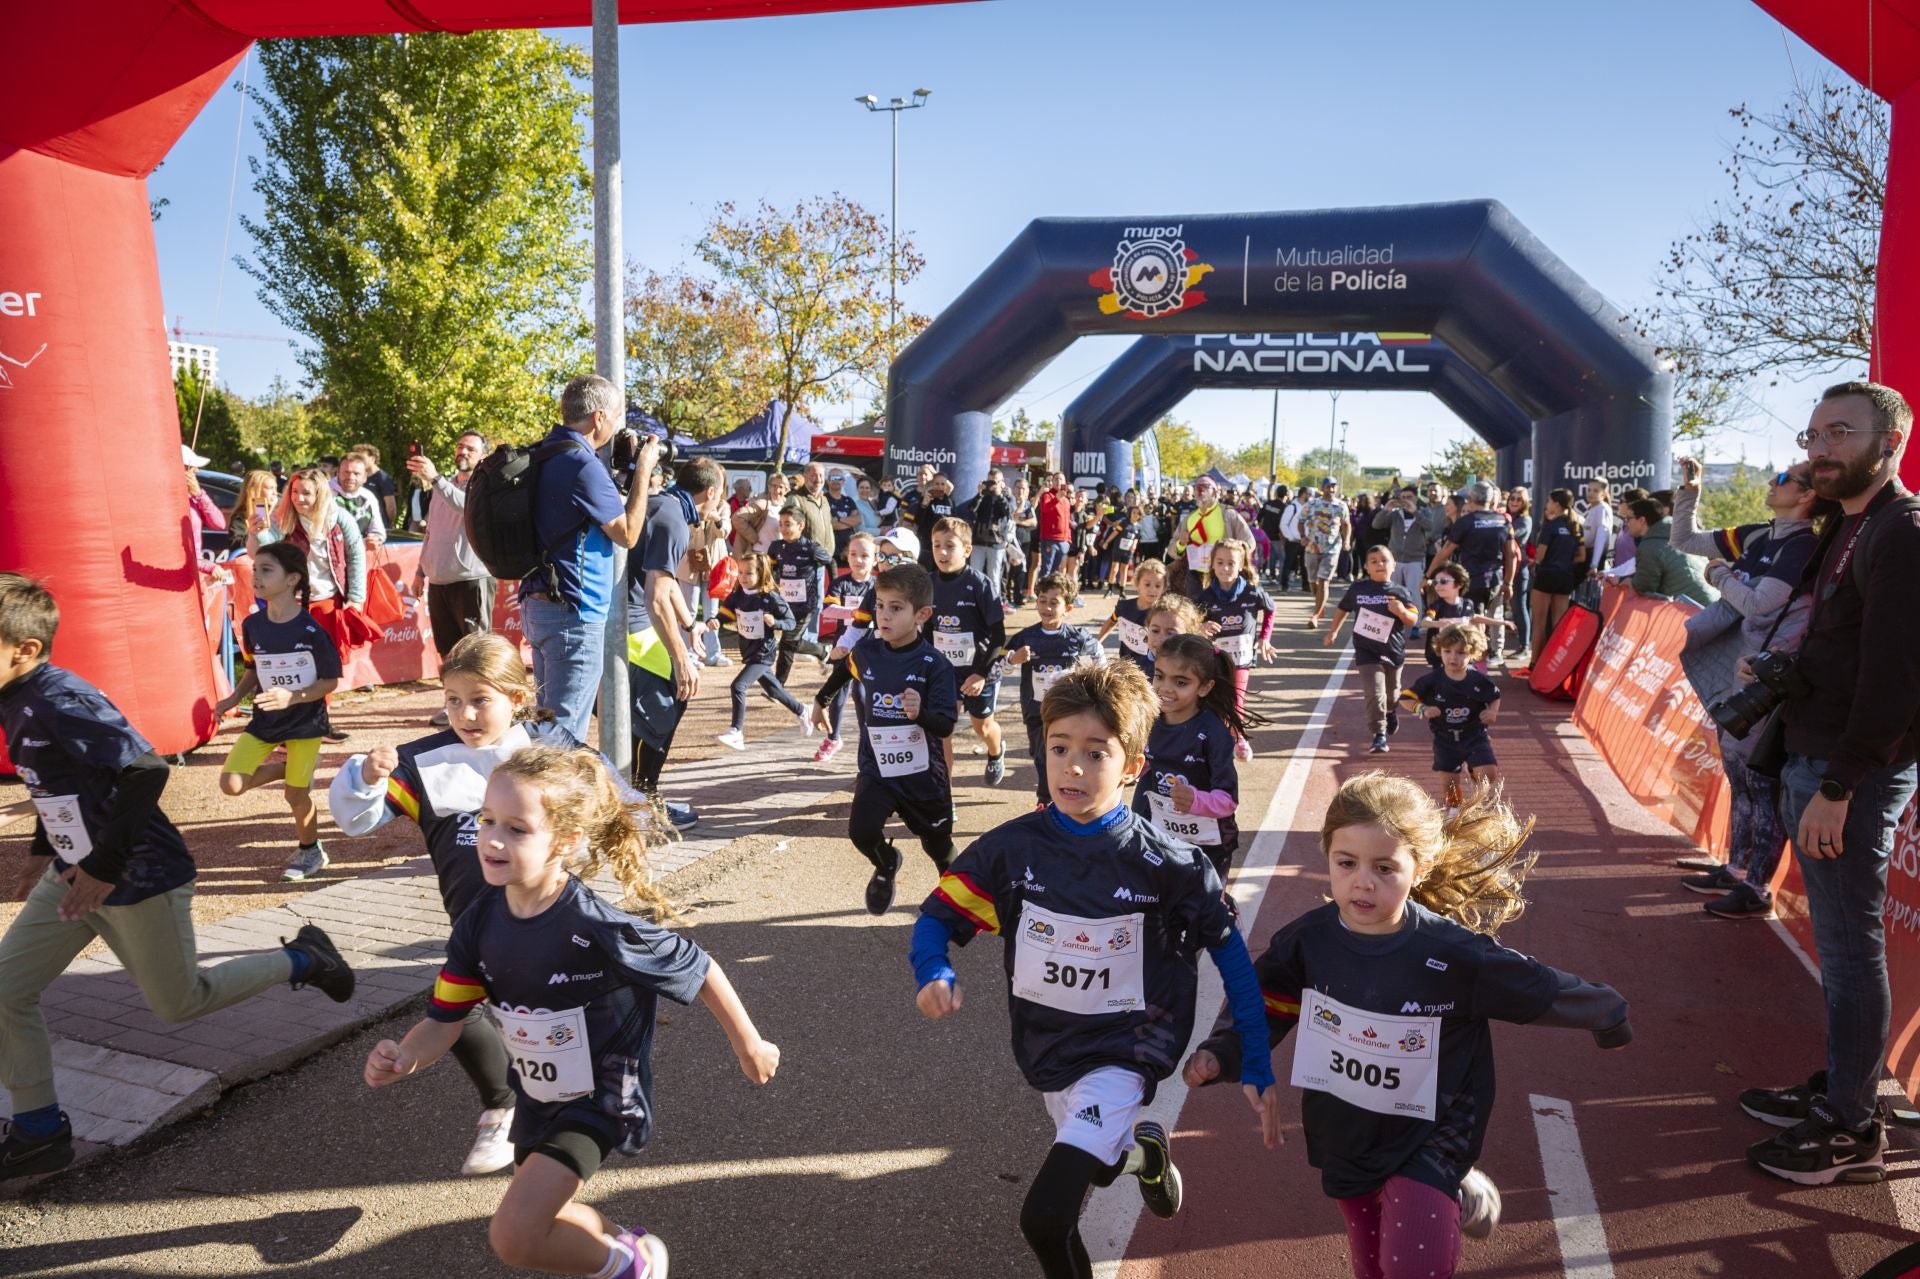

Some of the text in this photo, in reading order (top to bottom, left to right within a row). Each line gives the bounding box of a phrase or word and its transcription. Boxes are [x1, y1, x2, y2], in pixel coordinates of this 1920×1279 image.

[1124, 224, 1183, 241] mupol
[1276, 243, 1394, 266] Mutualidad
[1275, 269, 1407, 291] de la Policía
[1194, 350, 1430, 372] NACIONAL
[890, 444, 957, 463] fundación
[897, 463, 940, 476] mul
[1073, 452, 1106, 474] RUTA
[1563, 460, 1656, 480] fundación
[1362, 623, 1381, 635] 3065
[270, 674, 301, 686] 3031
[880, 751, 914, 765] 3069
[1163, 818, 1200, 835] 3088
[1028, 918, 1055, 936] 200
[1062, 940, 1103, 953] Santander
[572, 971, 604, 982] mupol
[1043, 961, 1110, 991] 3071
[1314, 1005, 1342, 1026] 200
[1424, 1001, 1455, 1013] mupol
[1348, 1033, 1391, 1050] Santander
[1329, 1050, 1401, 1090] 3005
[1075, 1112, 1103, 1128] adidas
